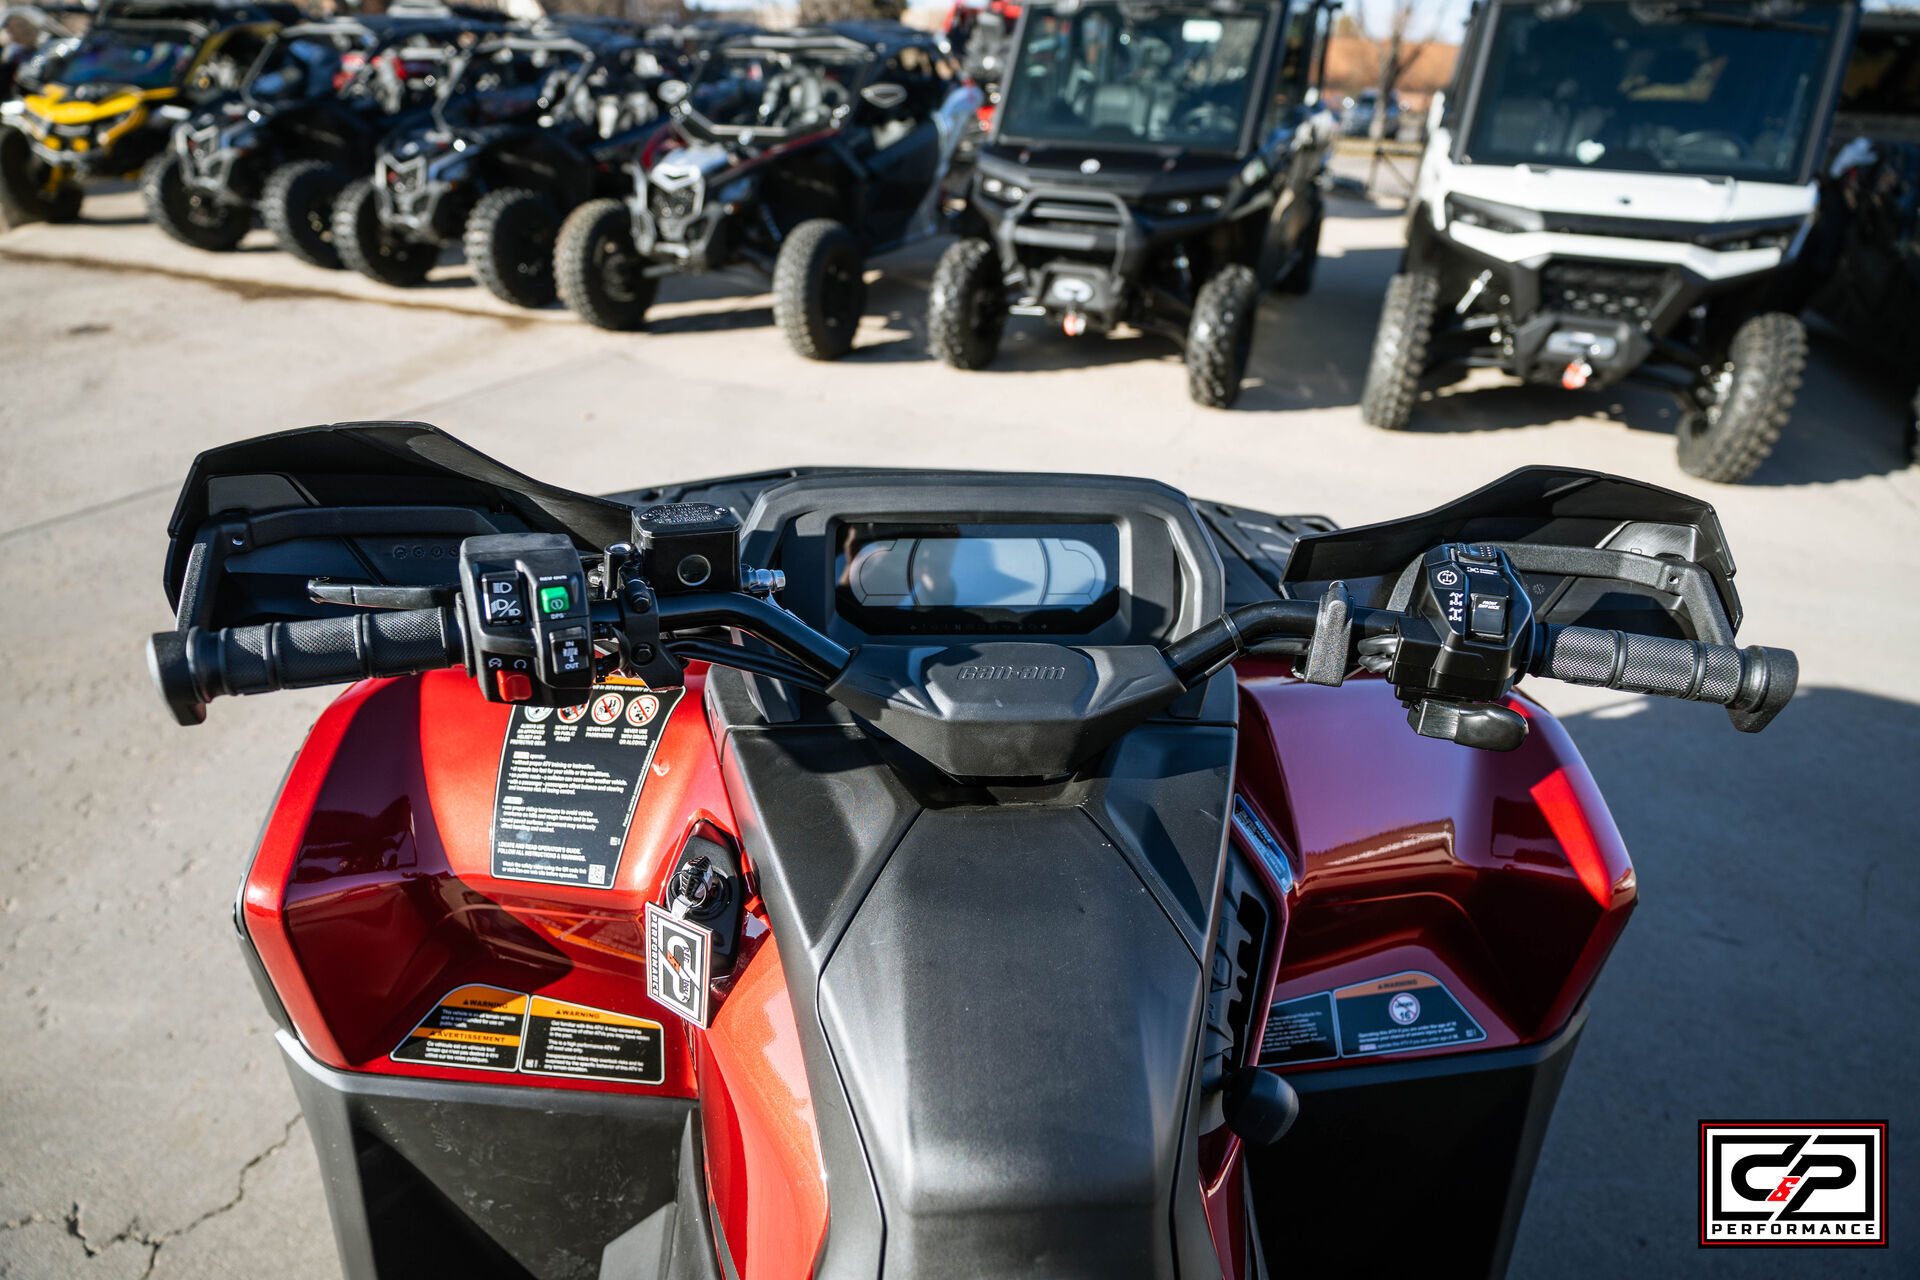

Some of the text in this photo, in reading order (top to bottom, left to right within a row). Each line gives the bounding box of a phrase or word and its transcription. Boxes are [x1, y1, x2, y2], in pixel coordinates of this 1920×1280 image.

[650, 914, 659, 997] PERFORMANCE
[470, 1000, 508, 1008] WARNING
[562, 1010, 600, 1018] WARNING
[438, 1030, 505, 1042] AVERTISSEMENT
